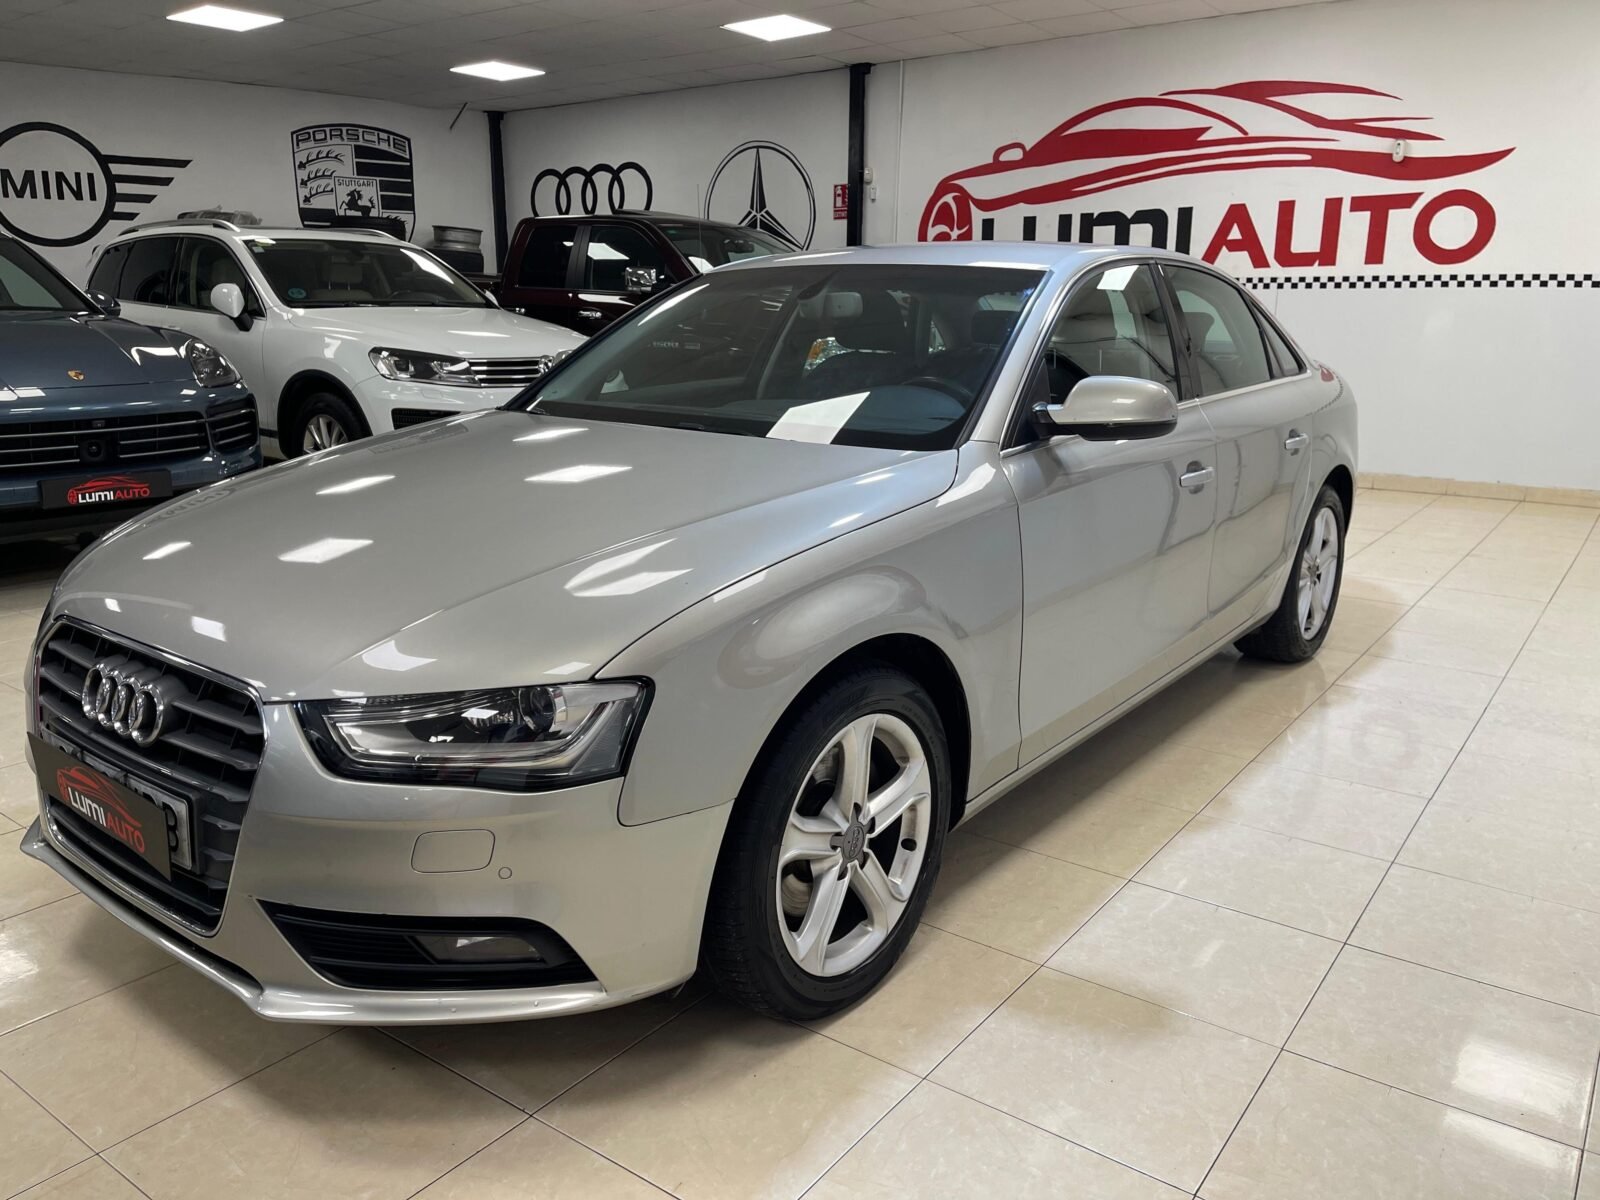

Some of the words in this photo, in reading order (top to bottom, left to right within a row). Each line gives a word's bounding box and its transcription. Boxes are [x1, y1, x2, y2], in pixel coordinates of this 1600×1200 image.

[295, 127, 408, 156] PORSCHE
[0, 168, 97, 201] MINI
[337, 178, 375, 188] STUTTGART
[78, 487, 151, 503] LUMIAUTO
[67, 787, 145, 854] LUMIAUTO
